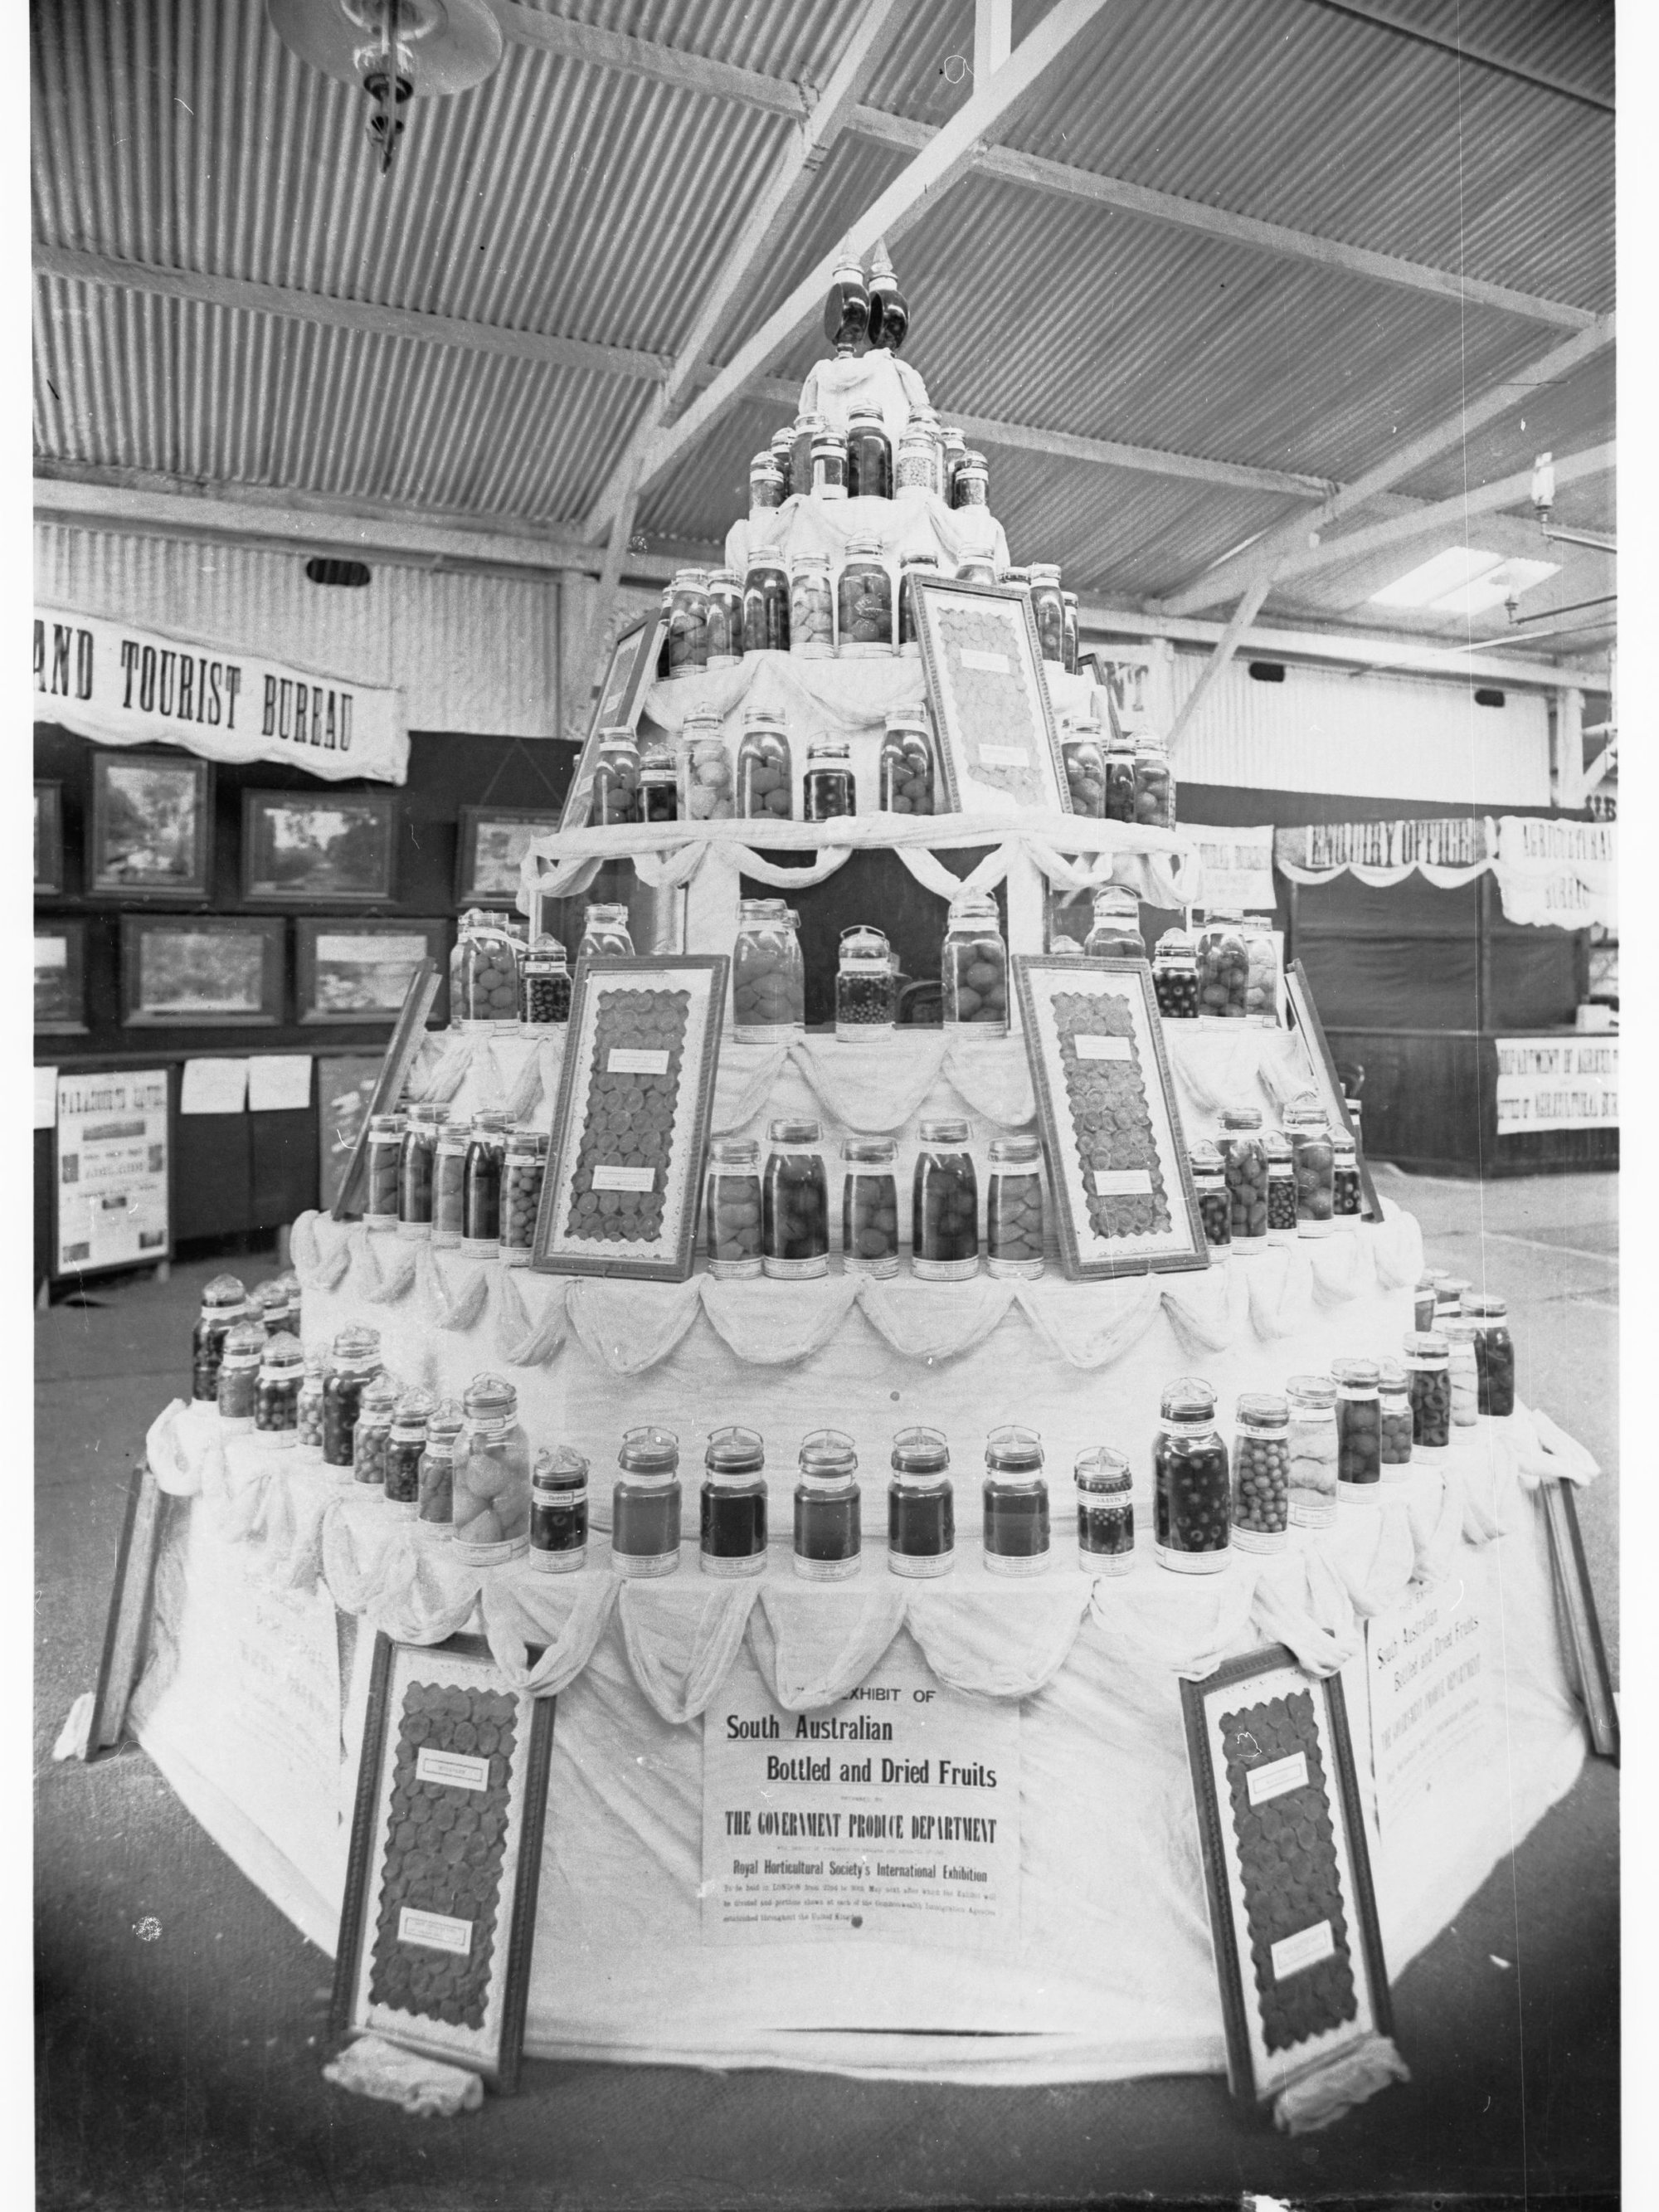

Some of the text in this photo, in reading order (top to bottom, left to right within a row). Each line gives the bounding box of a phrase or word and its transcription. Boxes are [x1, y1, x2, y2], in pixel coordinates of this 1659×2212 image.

[33, 619, 353, 751] AND TOURIST BUREAU
[1402, 820, 1475, 864] OFFICE
[1523, 823, 1613, 860] AGRICULTURAL
[841, 1688, 936, 1703] XHIBIT OF
[727, 1714, 893, 1741] South Australian
[767, 1755, 997, 1788] Bottled and Dried Fruits
[725, 1810, 997, 1843] THE GOVERNMENT PRODUCE DEPARTMENT
[733, 1860, 988, 1883] Royal Horticultural Society's International Exhibition
